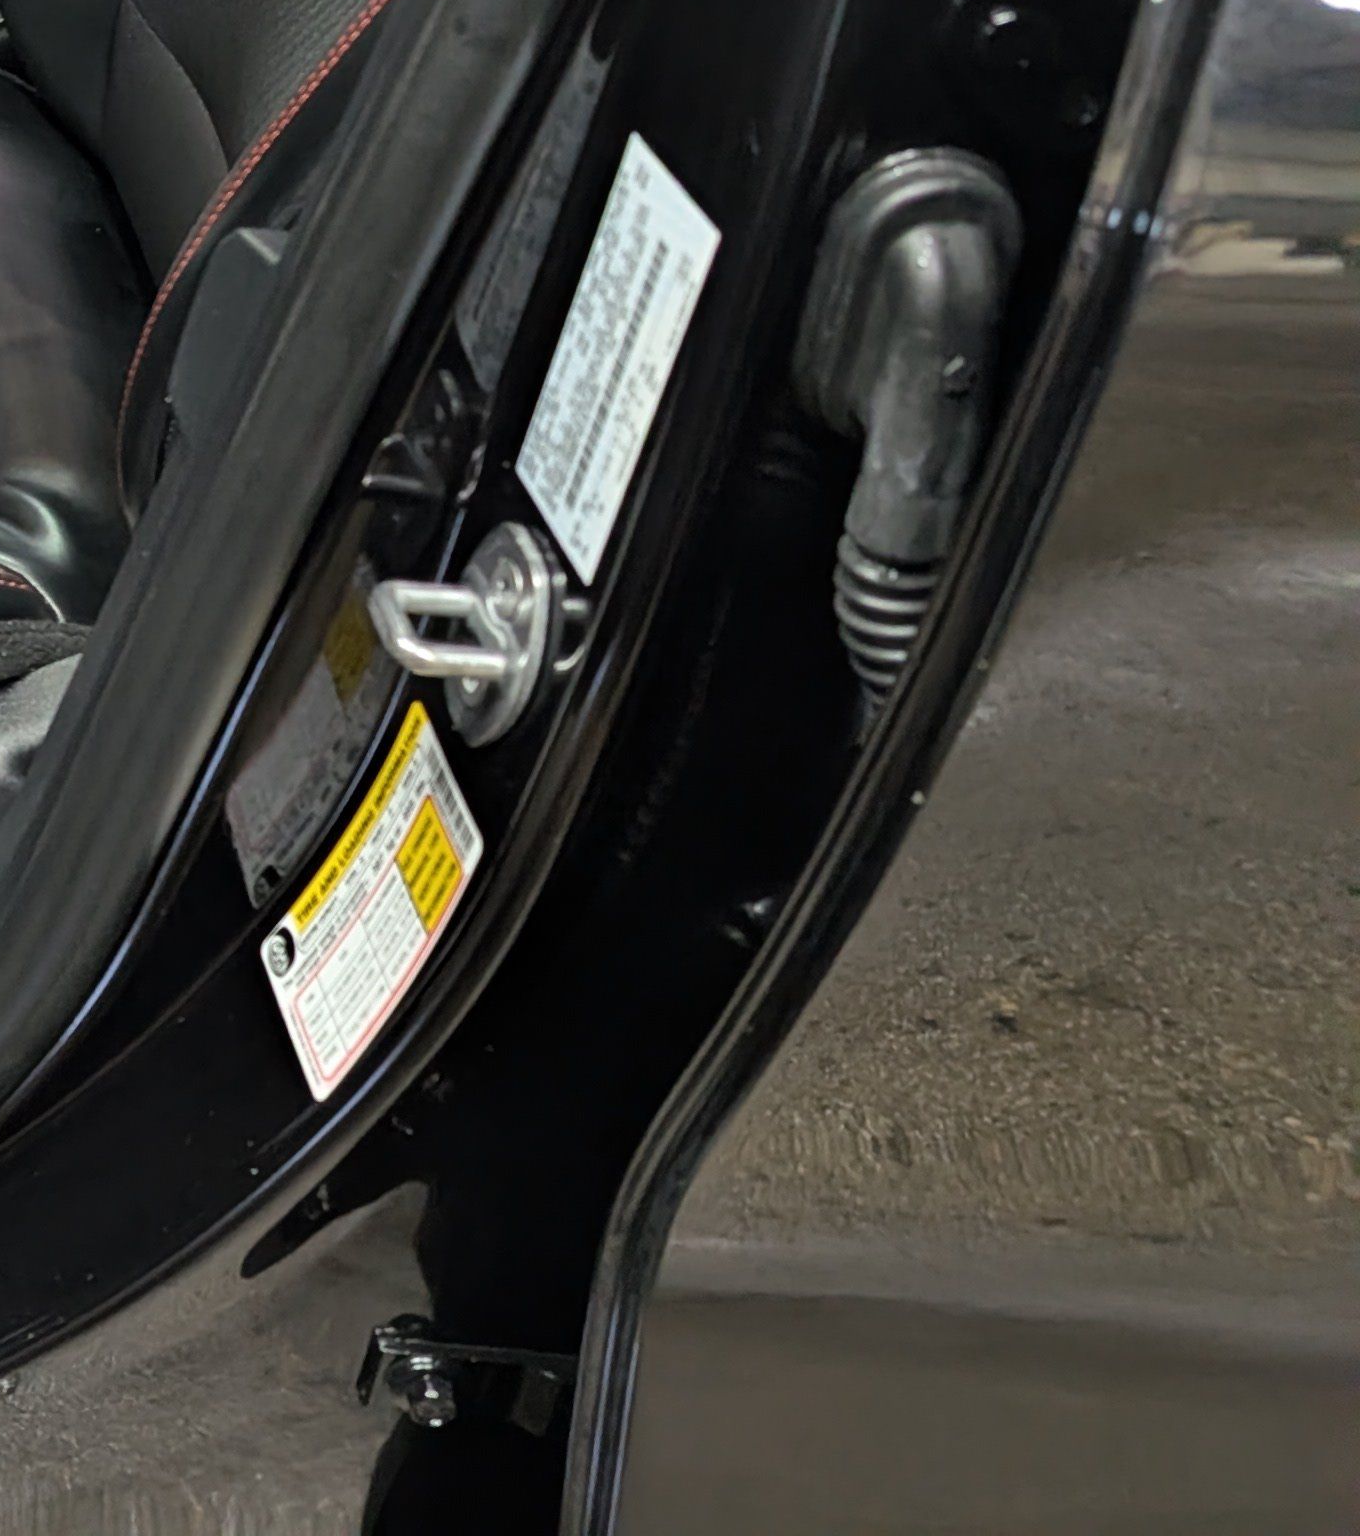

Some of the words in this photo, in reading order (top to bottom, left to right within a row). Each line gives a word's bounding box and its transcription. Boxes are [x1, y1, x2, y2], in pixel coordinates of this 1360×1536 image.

[296, 895, 319, 925] TIRE
[320, 866, 338, 895] AND
[337, 810, 374, 866] LOADING
[374, 718, 421, 808] INFORMATION
